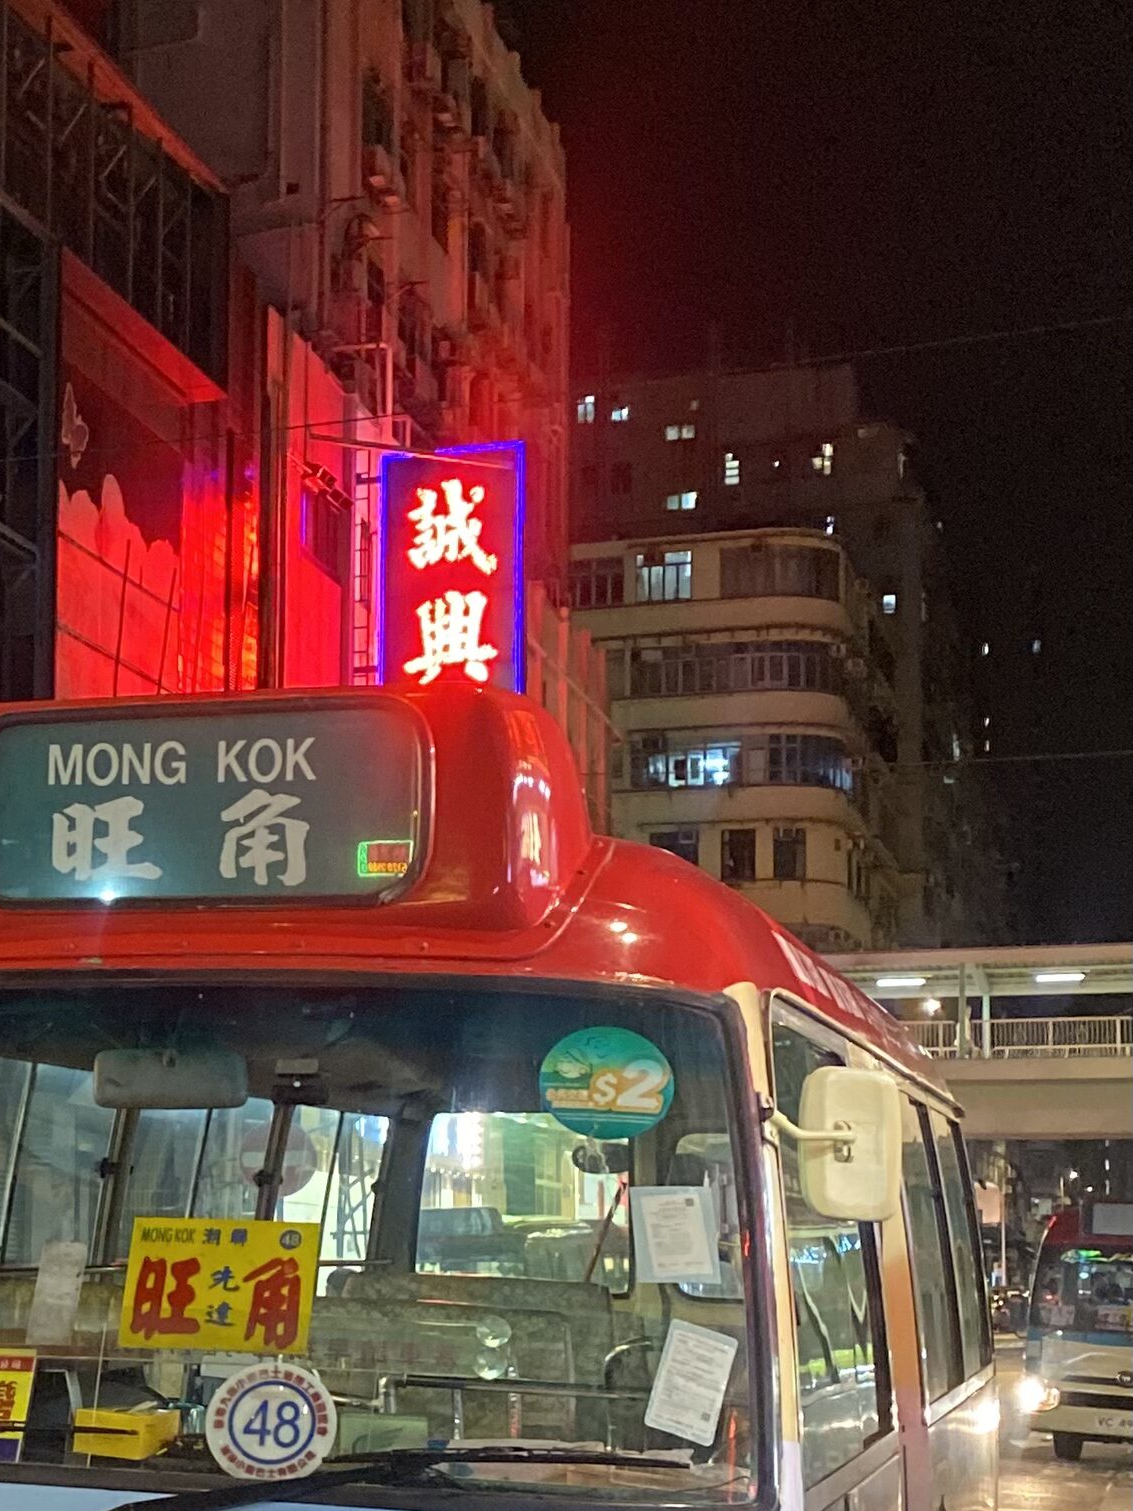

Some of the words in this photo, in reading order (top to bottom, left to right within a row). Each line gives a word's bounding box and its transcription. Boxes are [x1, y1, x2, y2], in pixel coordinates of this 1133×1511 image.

[403, 477, 499, 686] 誠興
[47, 740, 187, 786] MONG
[217, 736, 318, 783] KOK
[51, 788, 311, 887] 旺角
[593, 1059, 663, 1109] $2
[141, 1227, 173, 1242] MONG
[174, 1228, 196, 1244] KOK
[281, 1232, 300, 1246] 48
[130, 1256, 302, 1350] 旺角
[242, 1399, 301, 1449] 48
